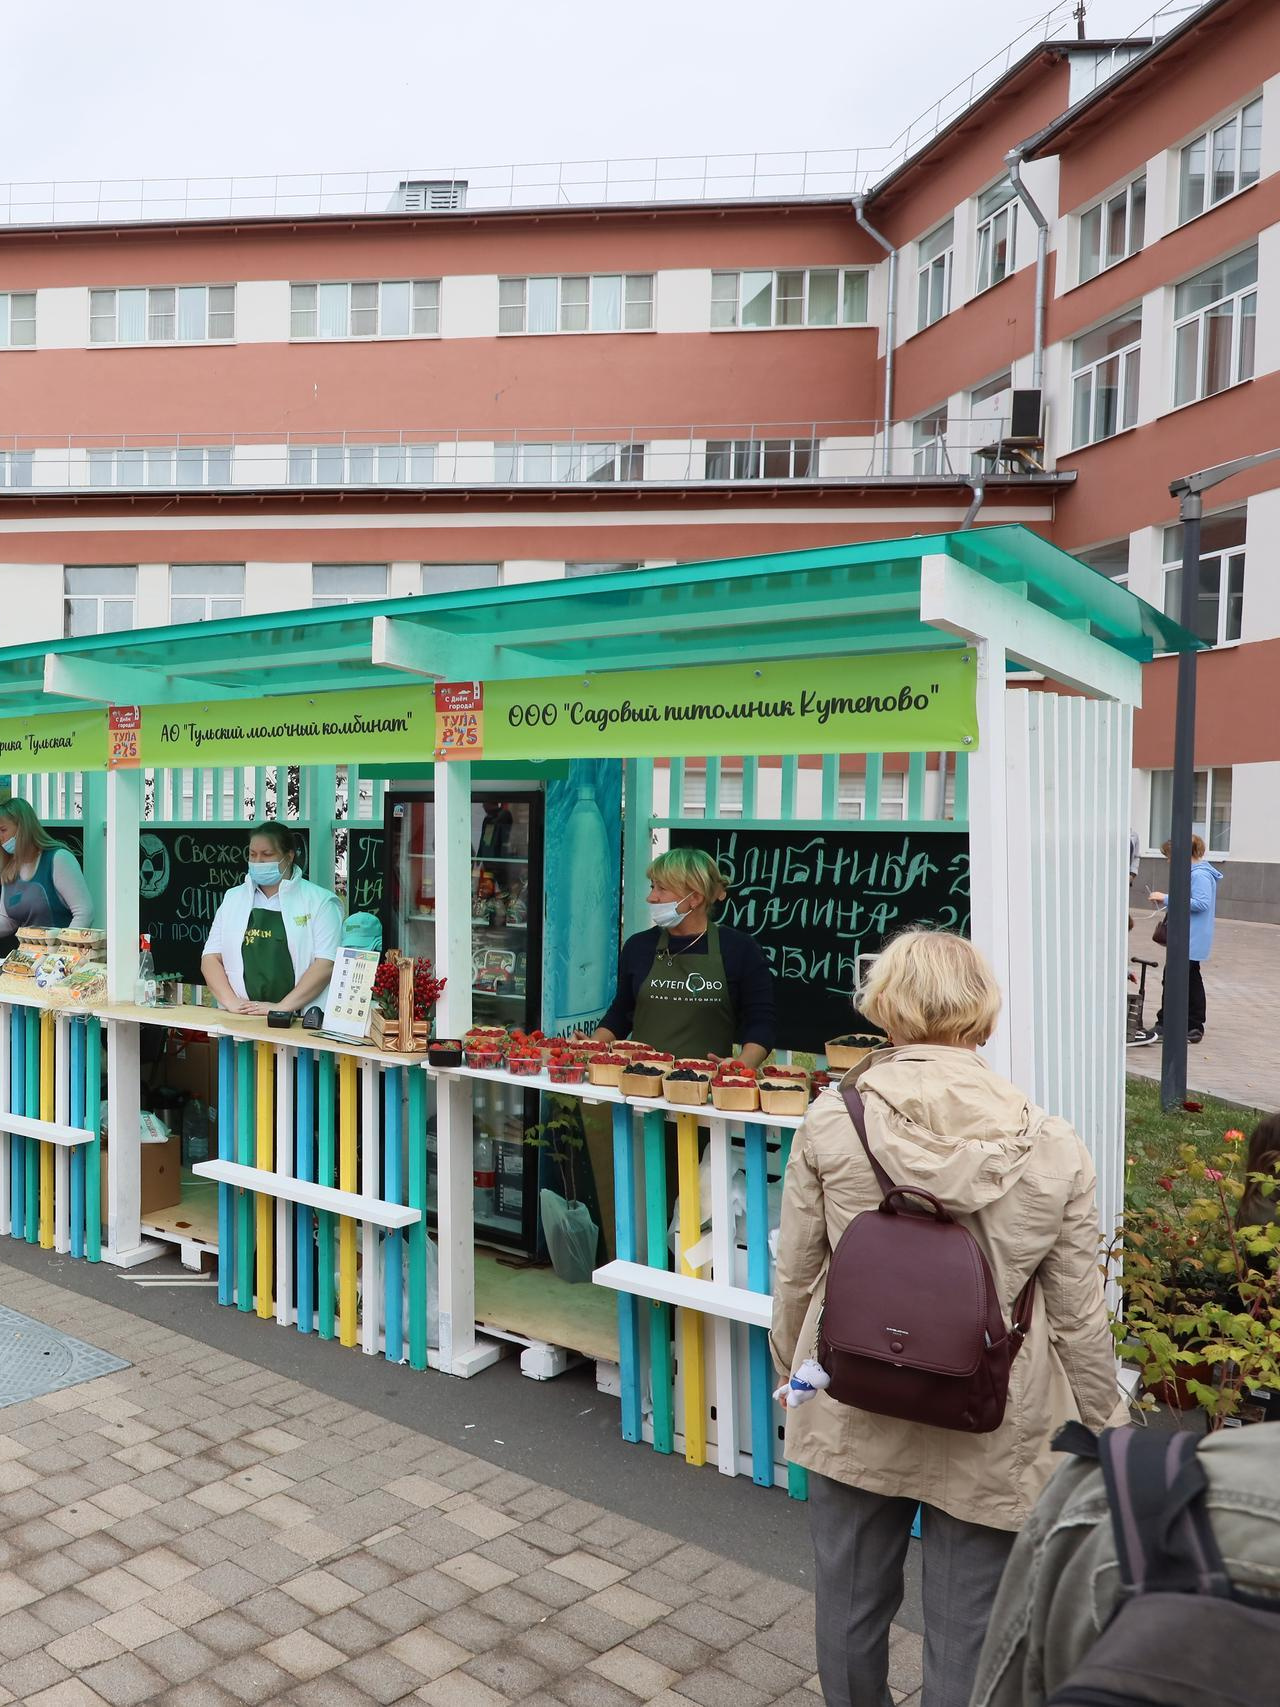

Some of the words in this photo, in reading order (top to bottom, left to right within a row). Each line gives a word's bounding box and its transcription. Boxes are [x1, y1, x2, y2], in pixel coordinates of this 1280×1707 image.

[508, 703, 558, 727] ООО
[564, 700, 661, 732] "Садовый
[664, 702, 795, 721] питомник
[800, 684, 940, 726] Кутепово"
[160, 723, 180, 743] АО
[183, 722, 245, 747] "Тульский
[246, 721, 321, 739] молочный
[321, 711, 413, 736] комбинат"
[650, 972, 723, 992] КУТЕПОВО
